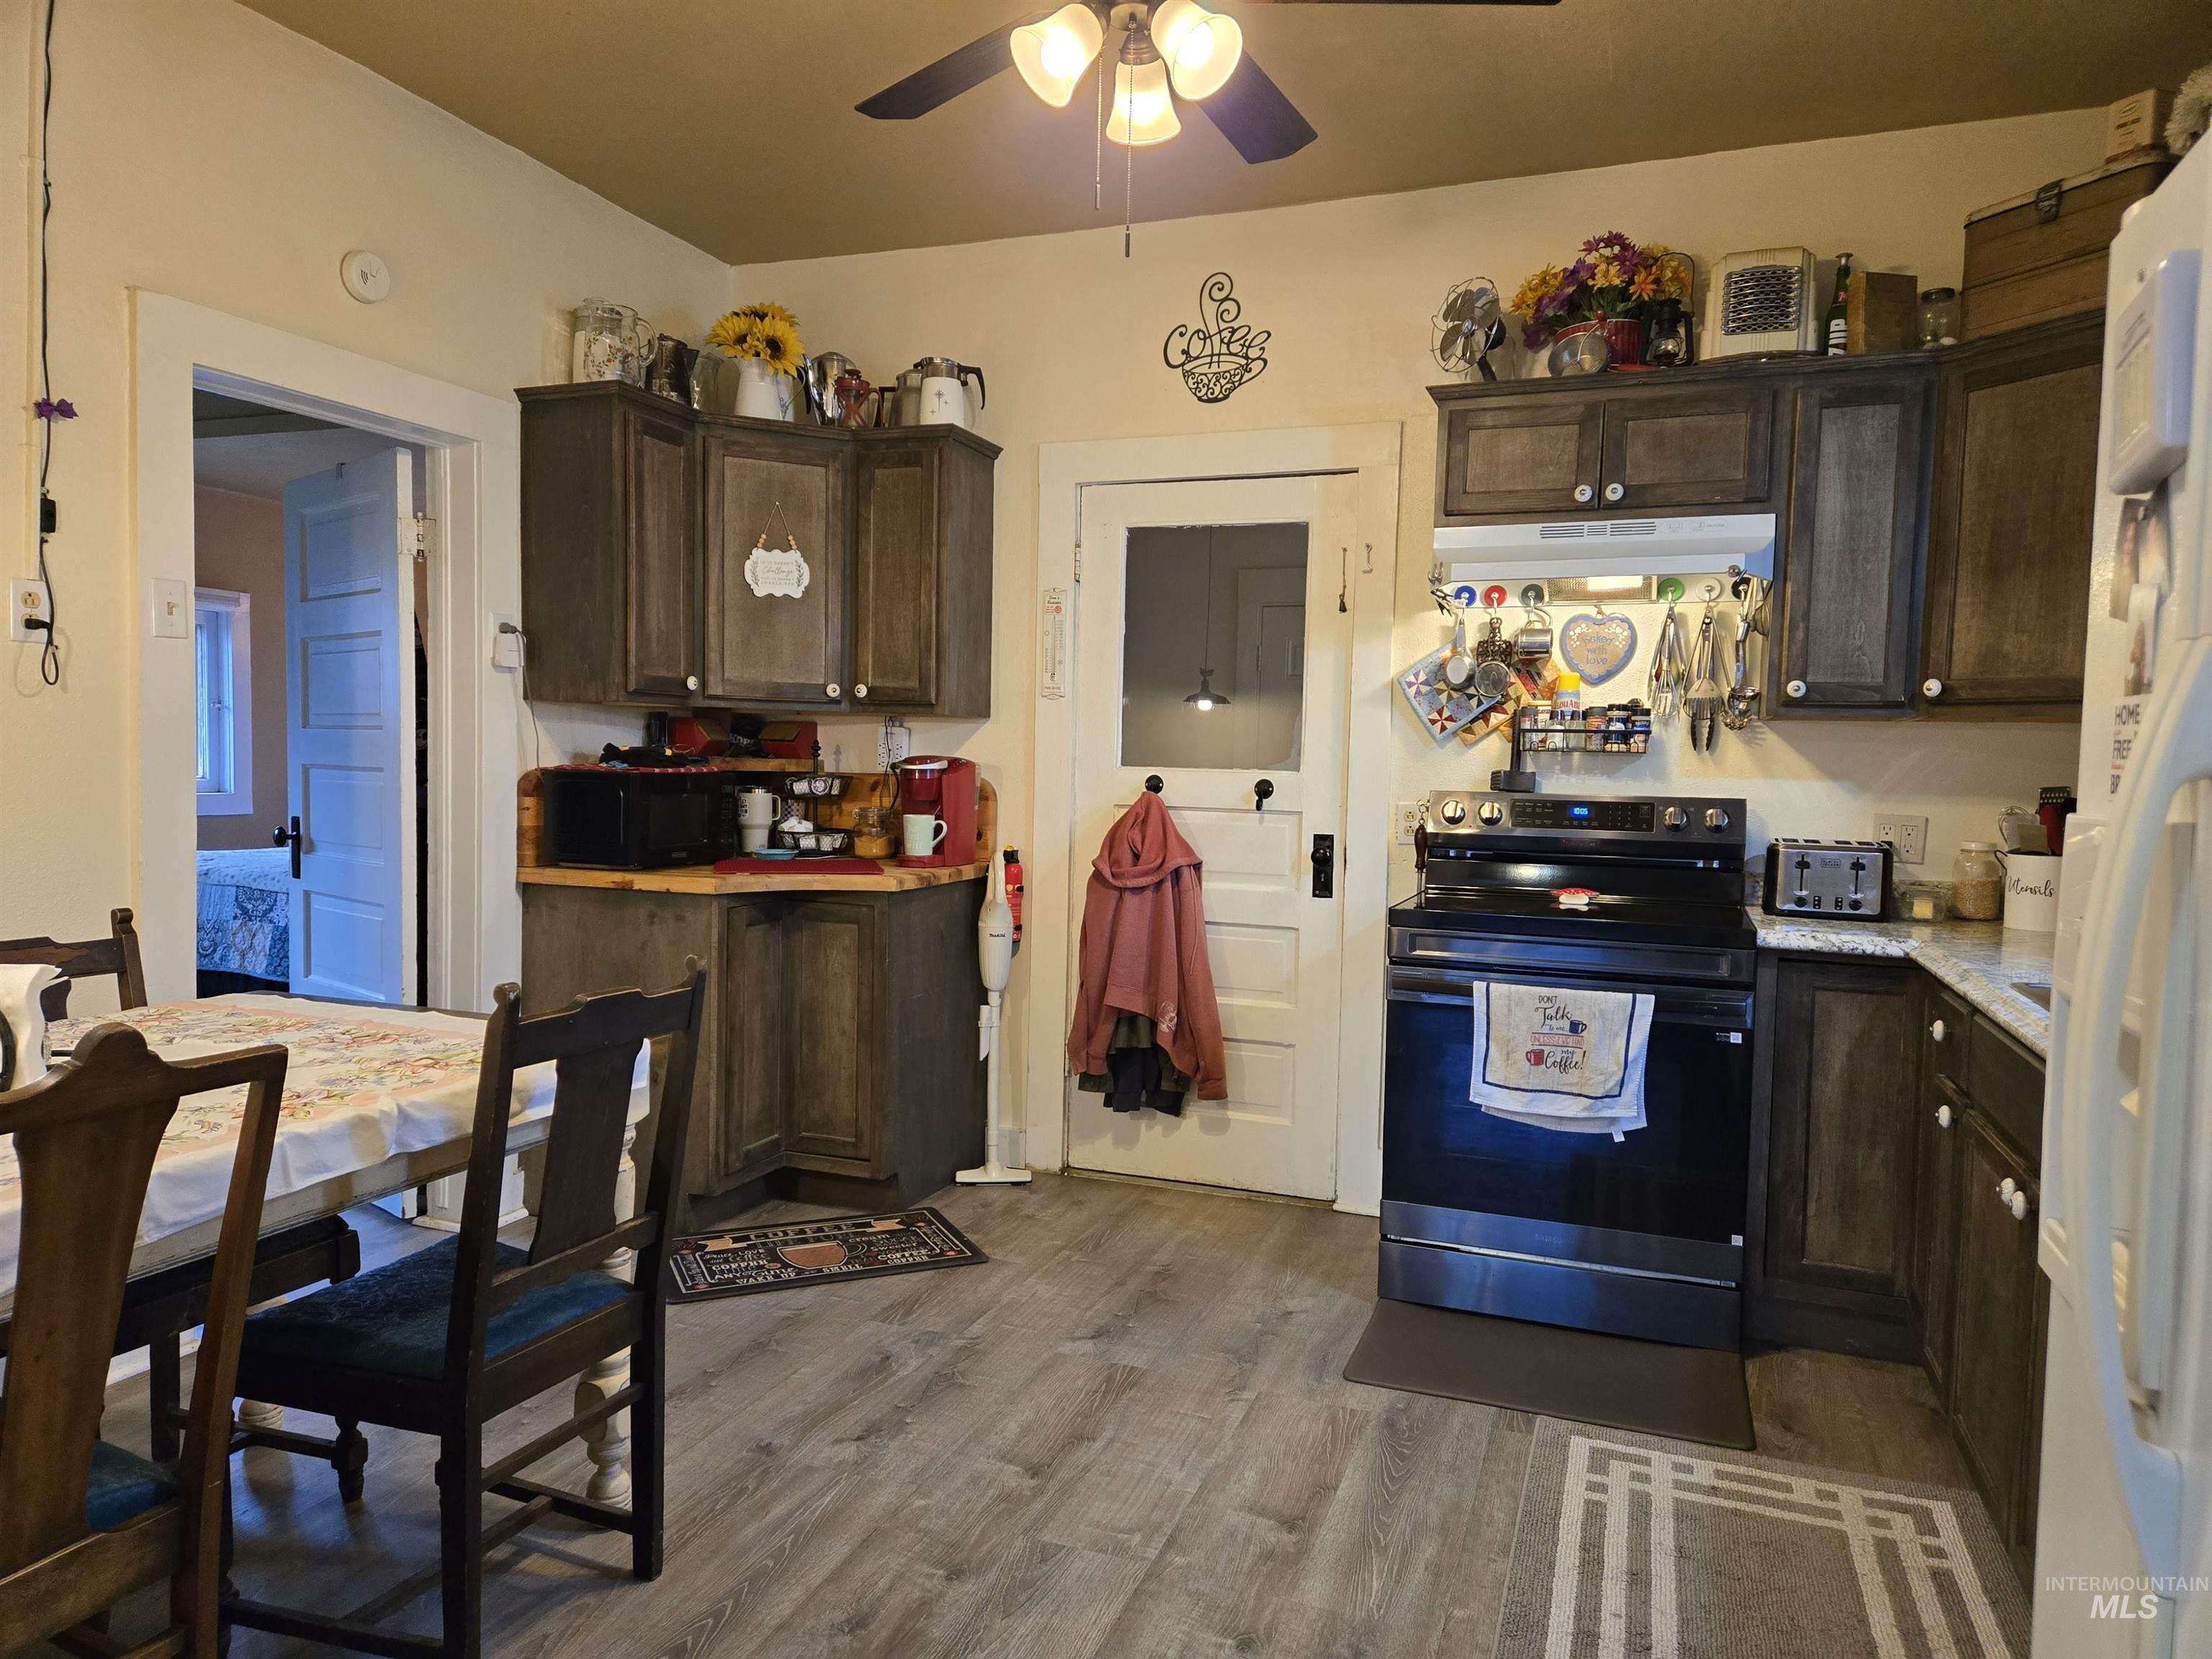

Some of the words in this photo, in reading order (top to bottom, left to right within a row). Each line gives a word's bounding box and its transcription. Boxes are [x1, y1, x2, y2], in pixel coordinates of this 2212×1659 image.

[1586, 655, 1608, 665] love
[2114, 704, 2141, 726] HOME
[2007, 875, 2055, 898] Utensils
[1534, 1004, 1573, 1028] Talk
[1530, 1035, 1556, 1044] UNLESS
[1572, 1037, 1585, 1046] HAD
[1545, 1051, 1586, 1074] Coffee!
[1561, 1049, 1575, 1059] my
[750, 1223, 857, 1240] COFFEE
[848, 1233, 890, 1242] cream
[735, 1274, 774, 1285] WAKE
[822, 1264, 863, 1273] SMELL
[887, 1255, 929, 1264] COFFEE
